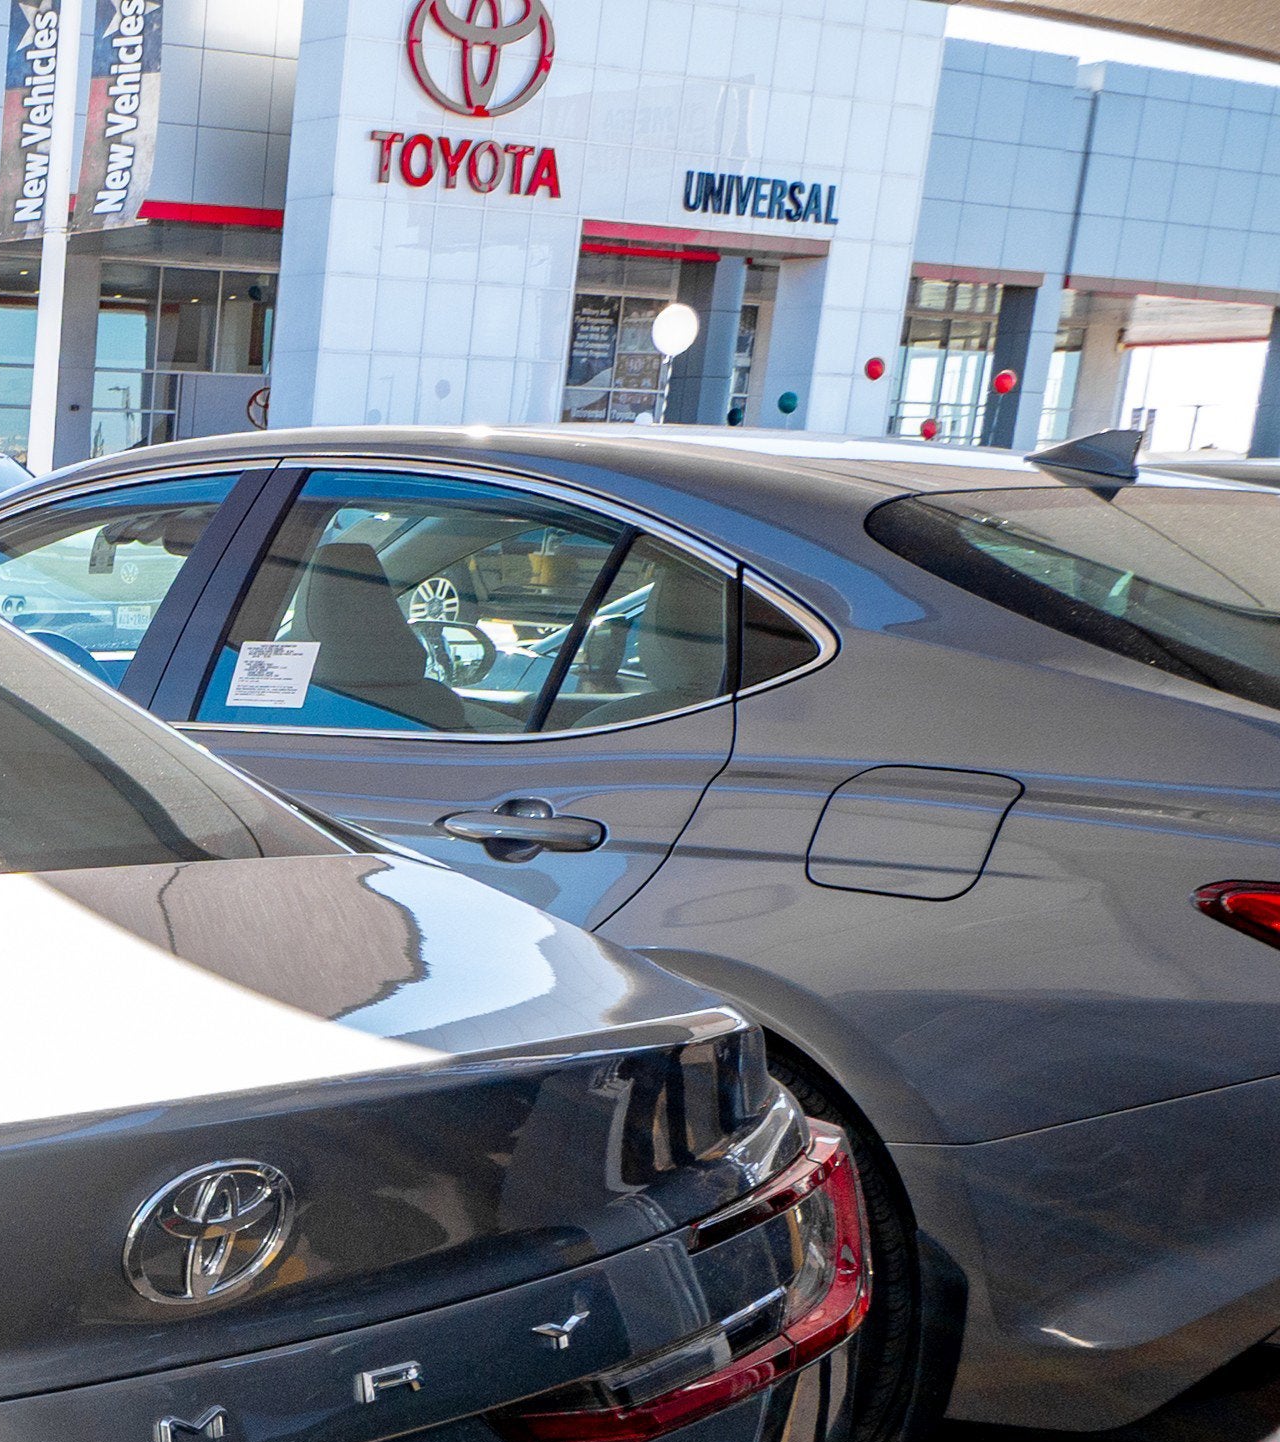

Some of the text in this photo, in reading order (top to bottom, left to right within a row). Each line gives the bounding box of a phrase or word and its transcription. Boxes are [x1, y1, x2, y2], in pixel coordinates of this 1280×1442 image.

[13, 11, 59, 222] New Vehicles
[93, 0, 145, 214] New Vehicles
[371, 130, 561, 199] TOYOTA
[683, 170, 840, 225] UNIVERSAL
